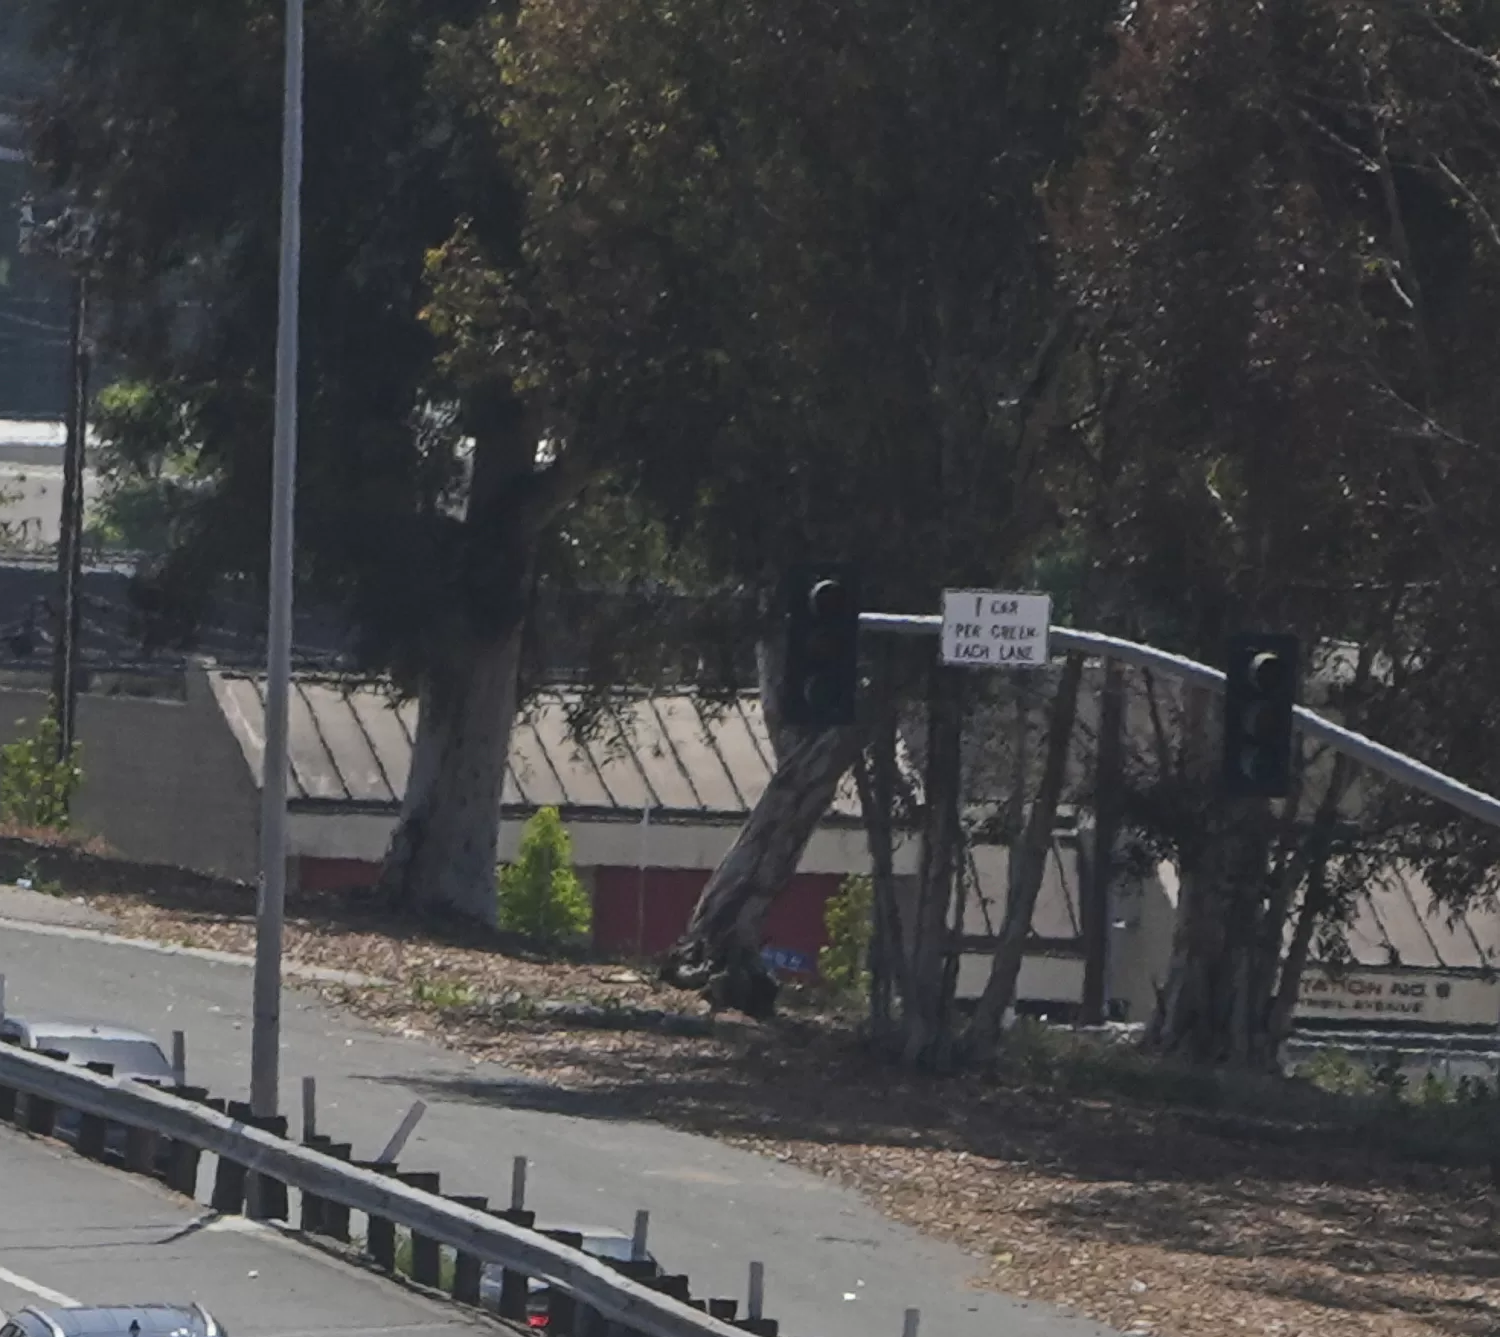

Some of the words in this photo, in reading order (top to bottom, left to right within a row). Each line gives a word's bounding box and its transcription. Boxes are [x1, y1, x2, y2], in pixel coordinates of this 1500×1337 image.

[954, 623, 982, 640] PER
[953, 642, 992, 660] EACH
[999, 642, 1035, 660] LANE
